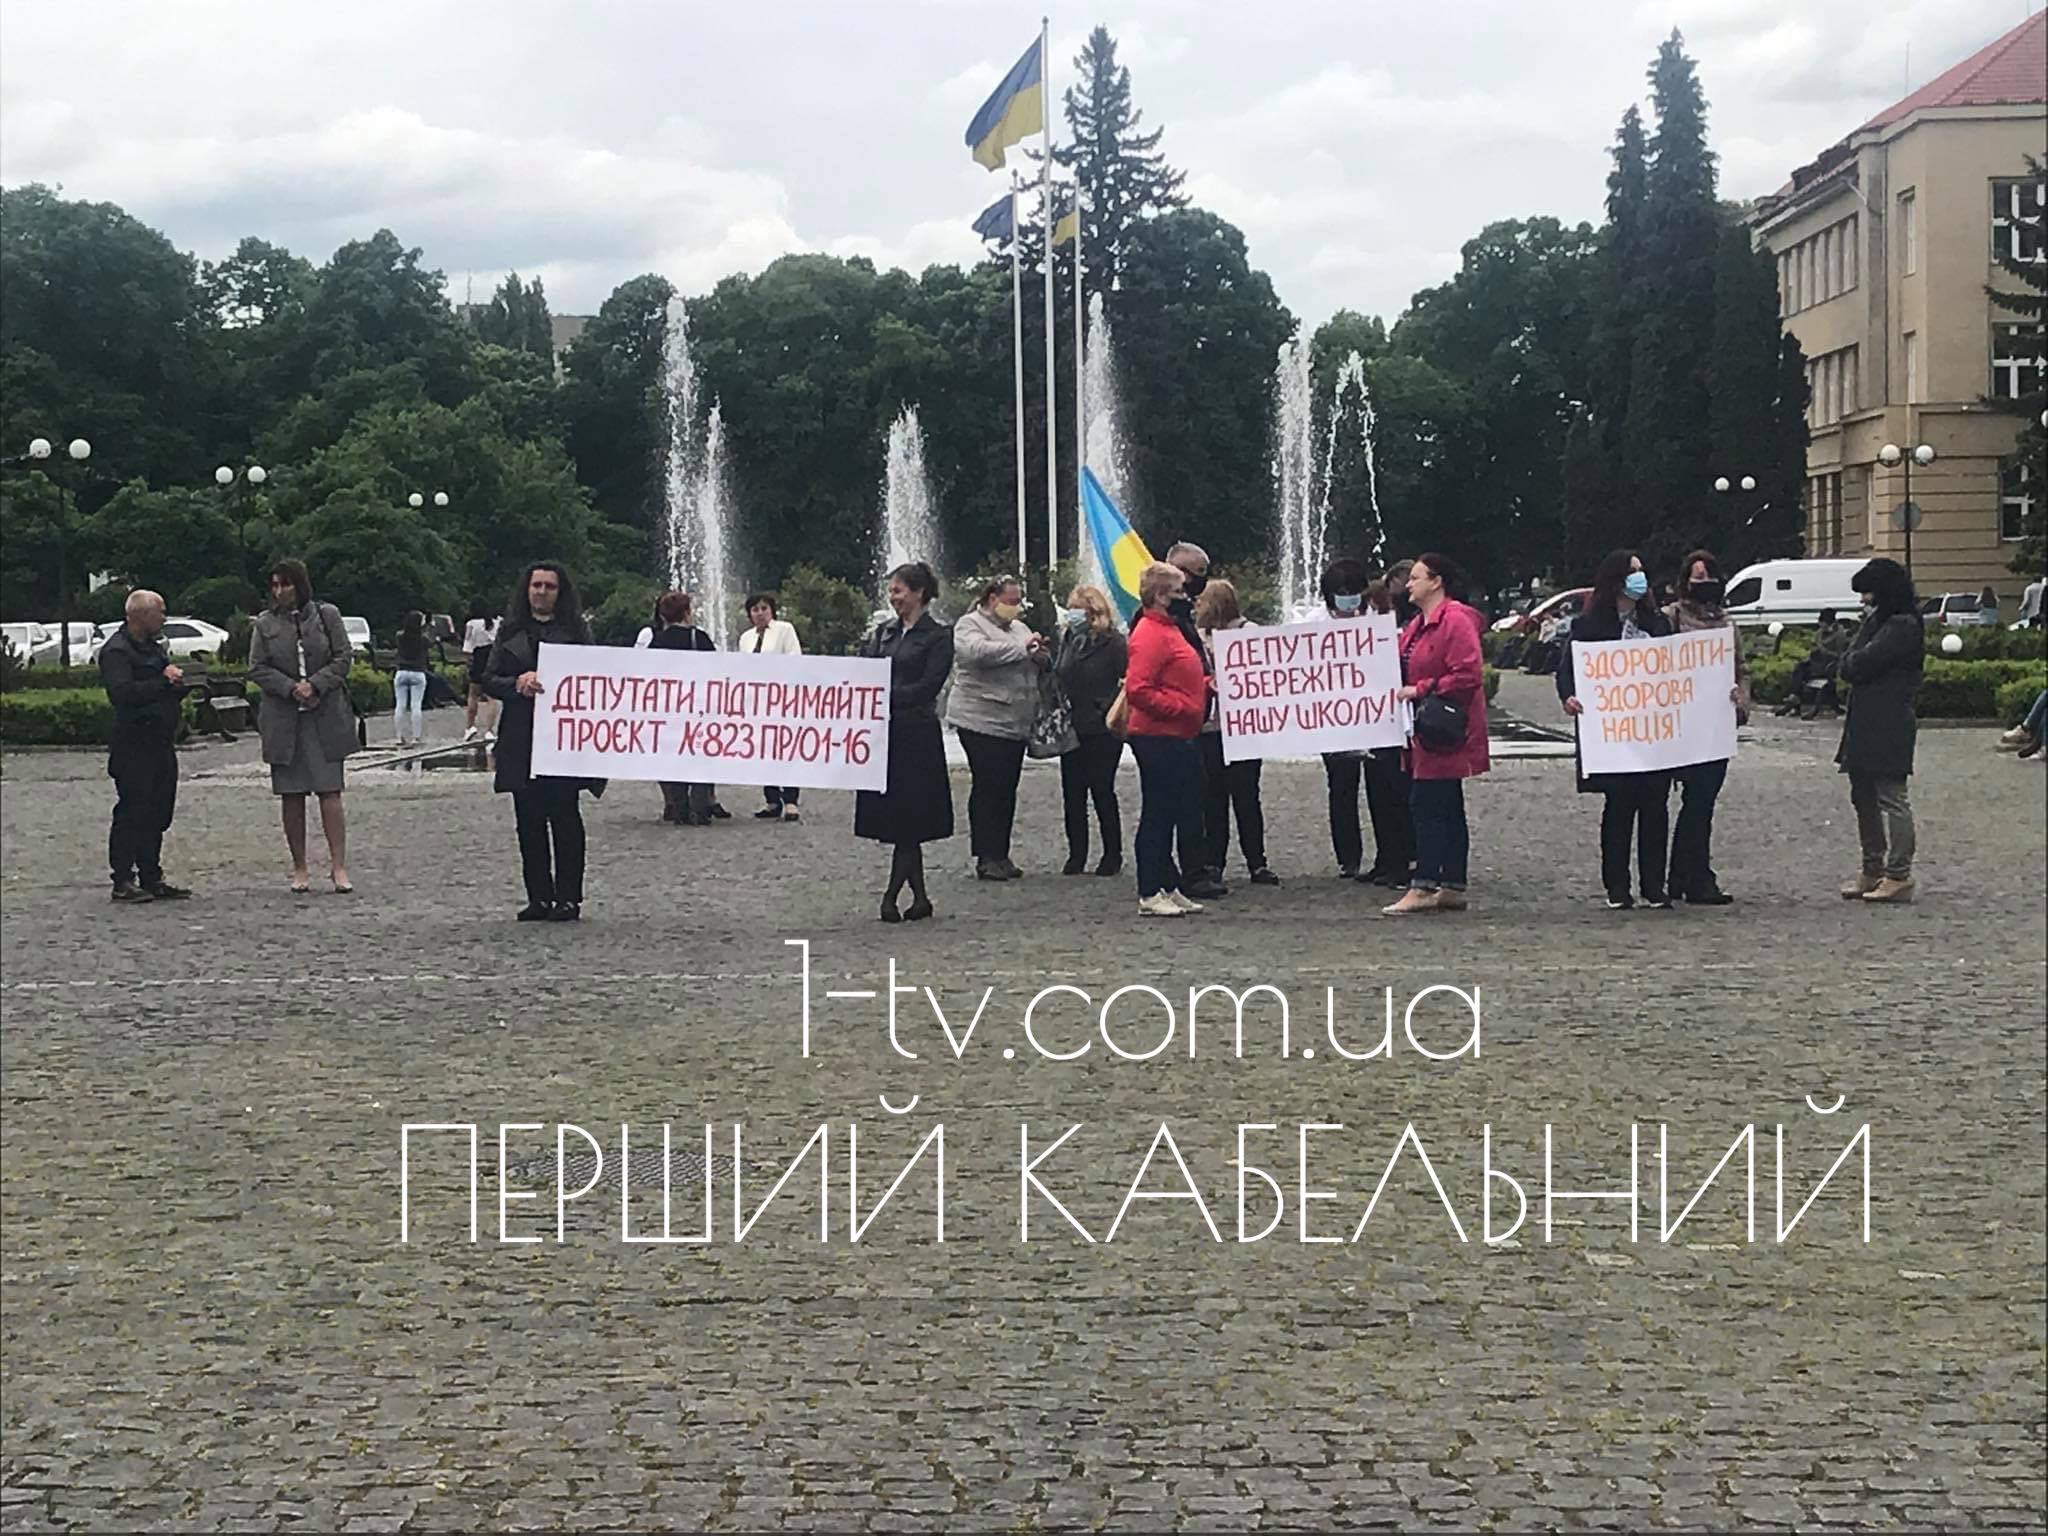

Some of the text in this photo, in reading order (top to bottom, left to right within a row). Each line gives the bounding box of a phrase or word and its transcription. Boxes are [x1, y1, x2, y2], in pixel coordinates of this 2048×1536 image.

[1225, 627, 1389, 672] ДЕПУТАТИ-
[1582, 645, 1674, 680] ЗДОРОВІ
[551, 675, 885, 721] ДЕПУТАТИ, ПІДТРИМАЙТЕ
[1227, 661, 1366, 701] ЗБЕРЕЖІТЬ
[1593, 677, 1694, 713] ЗДОРОВА
[1225, 688, 1396, 737] НАШУ ШКОЛУ!
[1602, 709, 1683, 745] НАЦІЯ!
[557, 718, 666, 754] ПРОЄКТ
